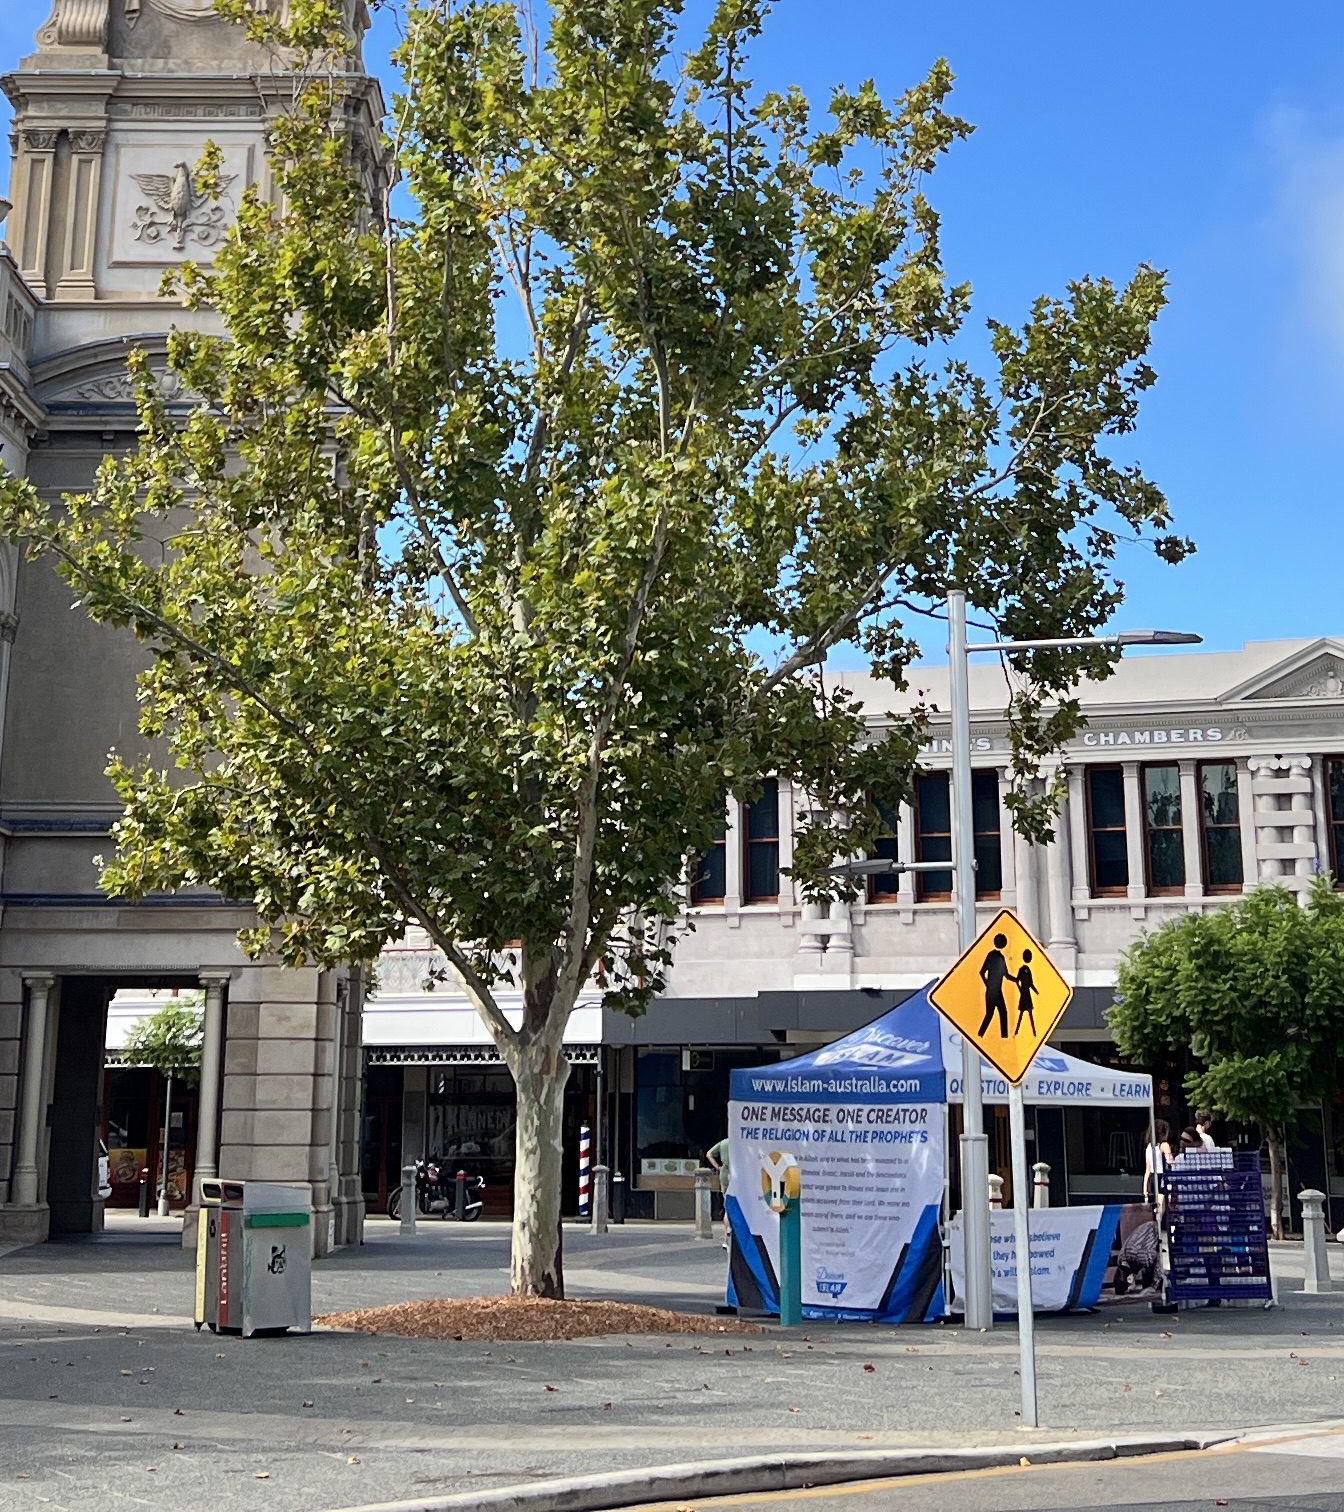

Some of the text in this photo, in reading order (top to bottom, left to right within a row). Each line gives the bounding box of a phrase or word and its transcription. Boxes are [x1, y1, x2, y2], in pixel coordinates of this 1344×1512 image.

[1083, 728, 1223, 746] CHAMBERS
[1037, 1080, 1093, 1097] EXPLORE
[1112, 1082, 1151, 1099] LEARN
[741, 1105, 768, 1122] ONE
[836, 1108, 864, 1124] ONE
[866, 1107, 929, 1125] CREATOR
[740, 1127, 928, 1144] THE RELIGION OF ALL THE PROPHETS
